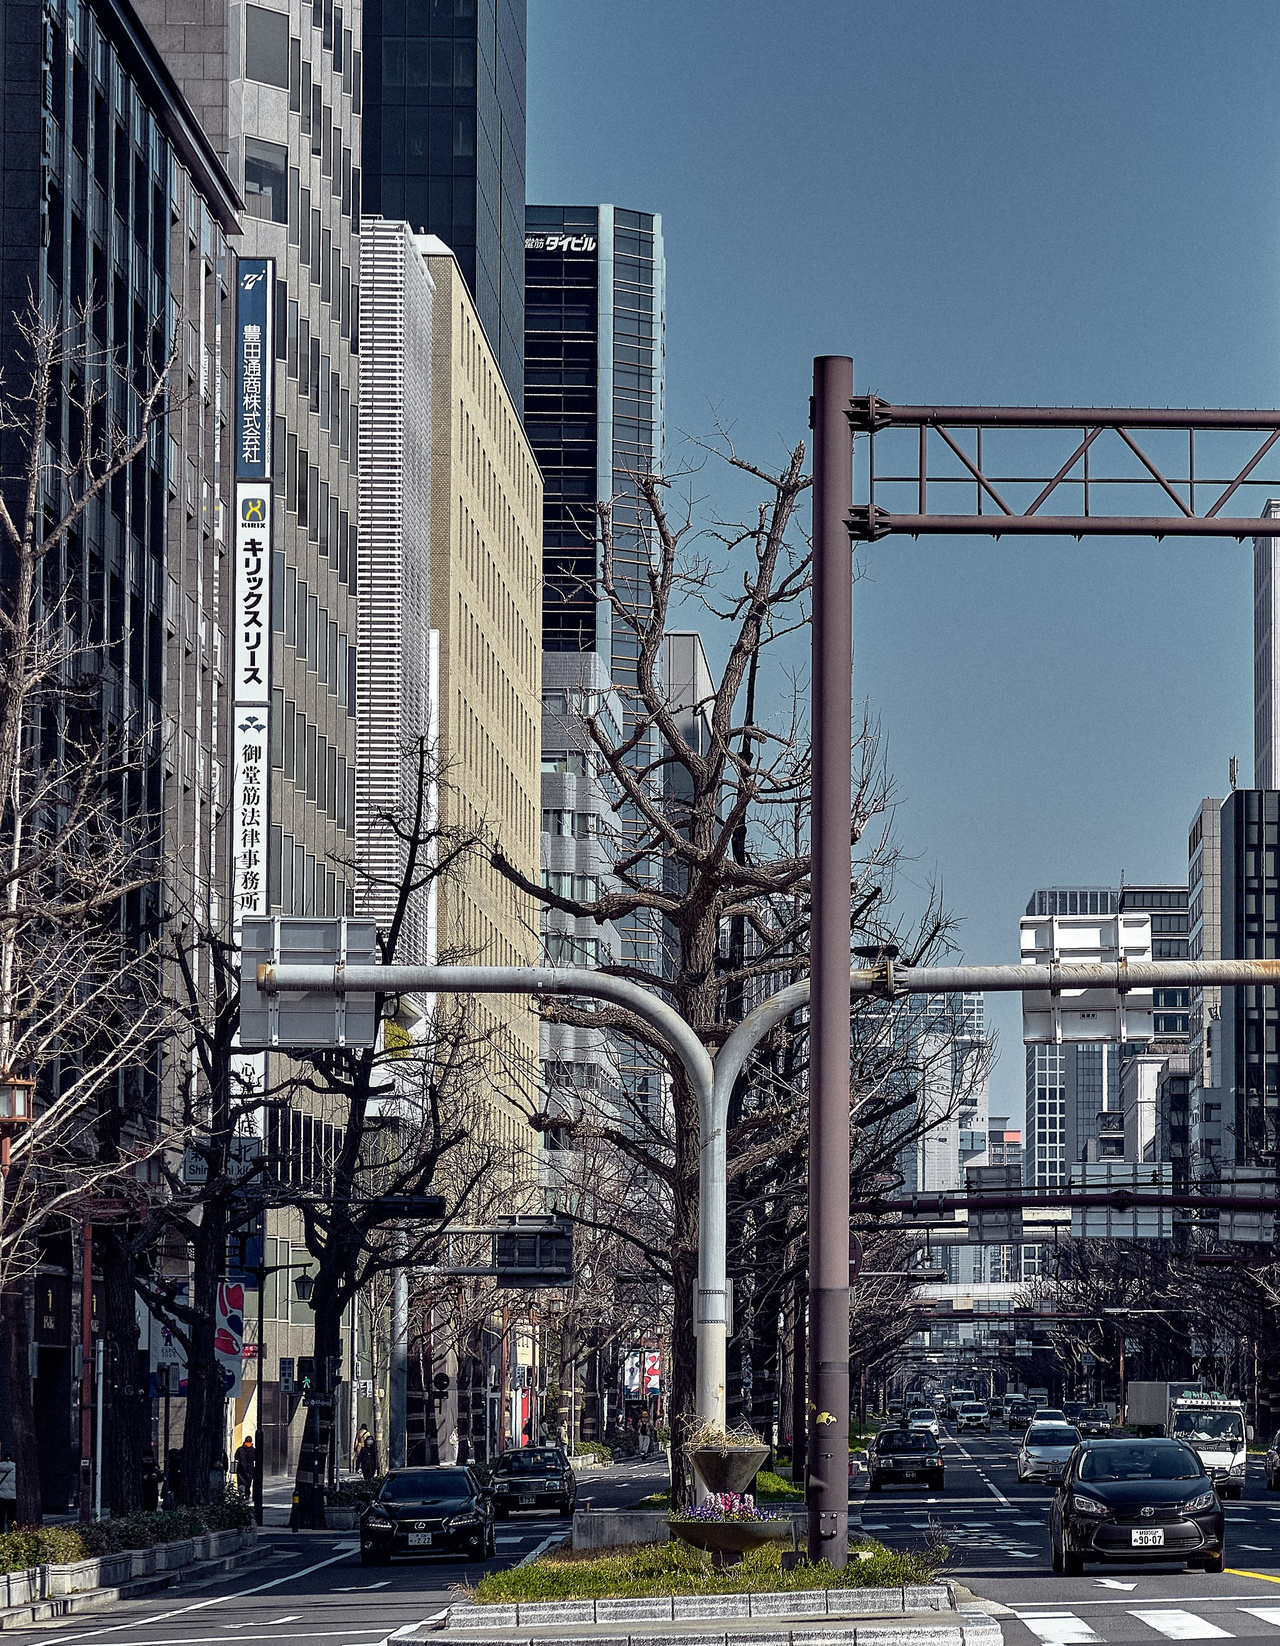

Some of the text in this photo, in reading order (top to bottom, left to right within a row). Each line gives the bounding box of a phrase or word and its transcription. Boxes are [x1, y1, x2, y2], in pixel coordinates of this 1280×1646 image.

[241, 323, 262, 464] 豊田通商株式会社
[242, 538, 264, 685] キリックスリース
[240, 743, 262, 912] 御堂筋法律事務所
